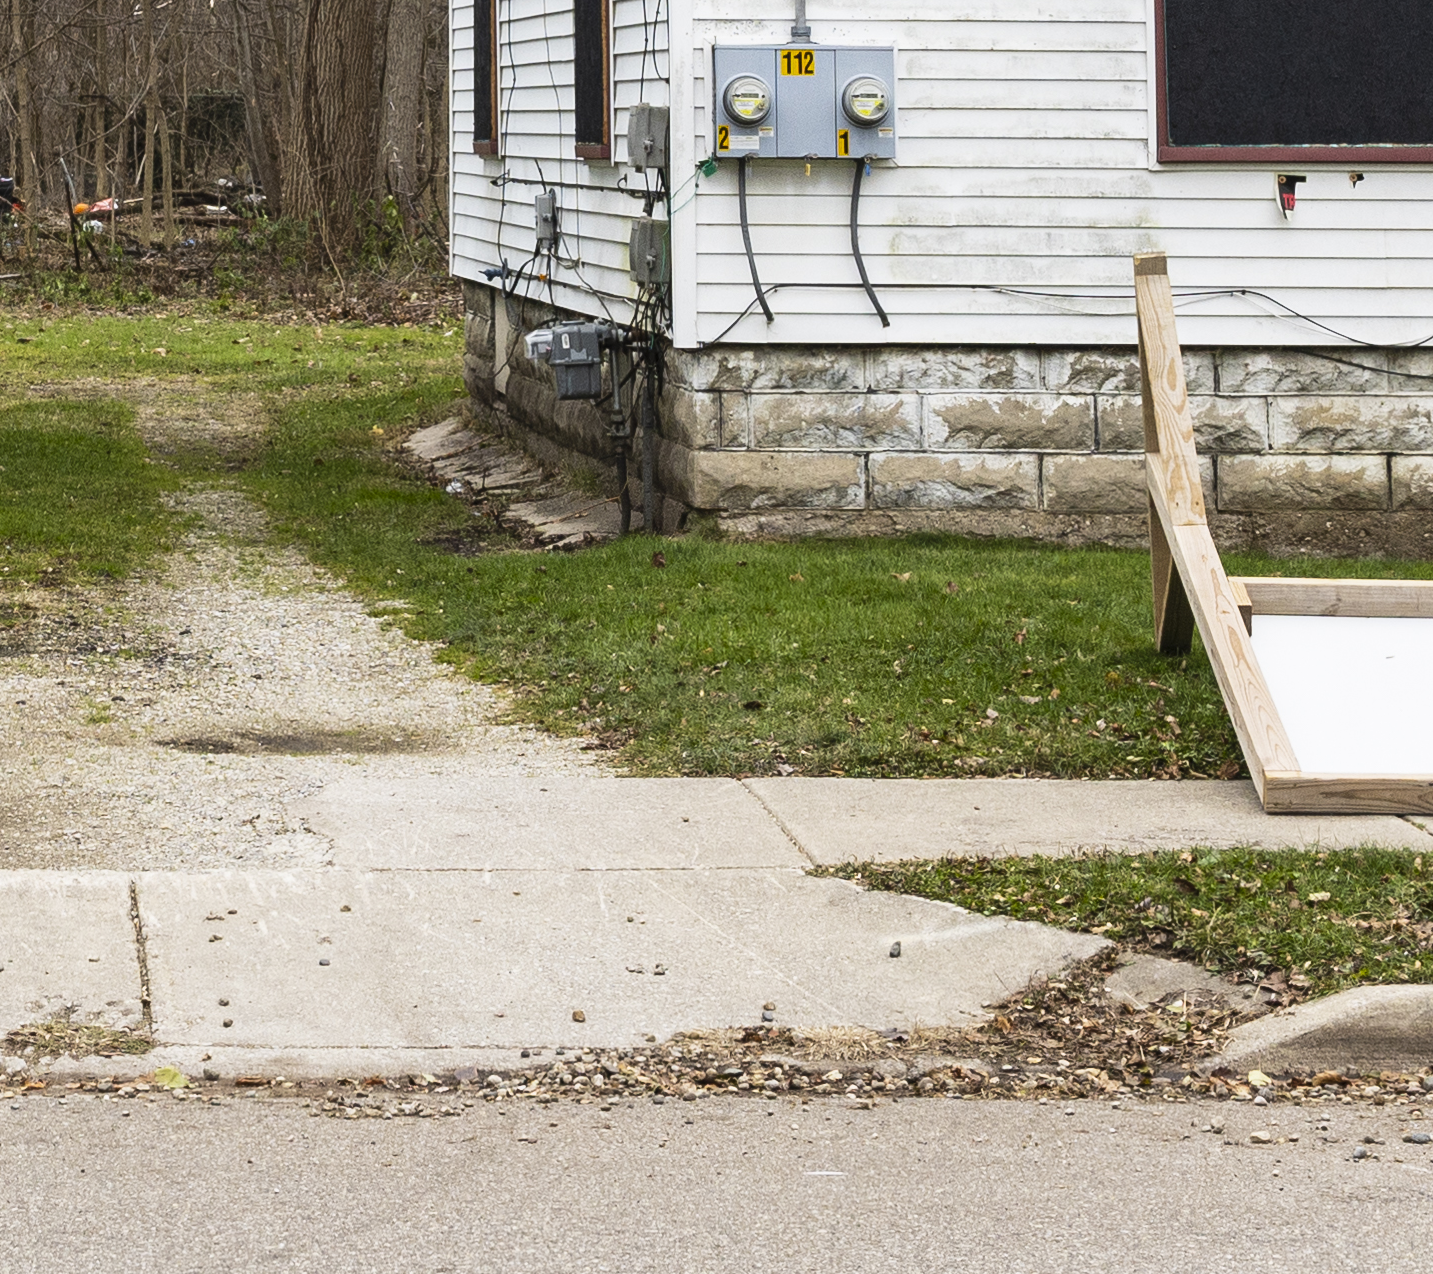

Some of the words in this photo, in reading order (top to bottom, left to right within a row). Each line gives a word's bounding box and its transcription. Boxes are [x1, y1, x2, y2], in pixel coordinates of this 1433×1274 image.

[782, 51, 814, 75] 112
[719, 127, 729, 149] 2
[839, 131, 848, 154] 1
